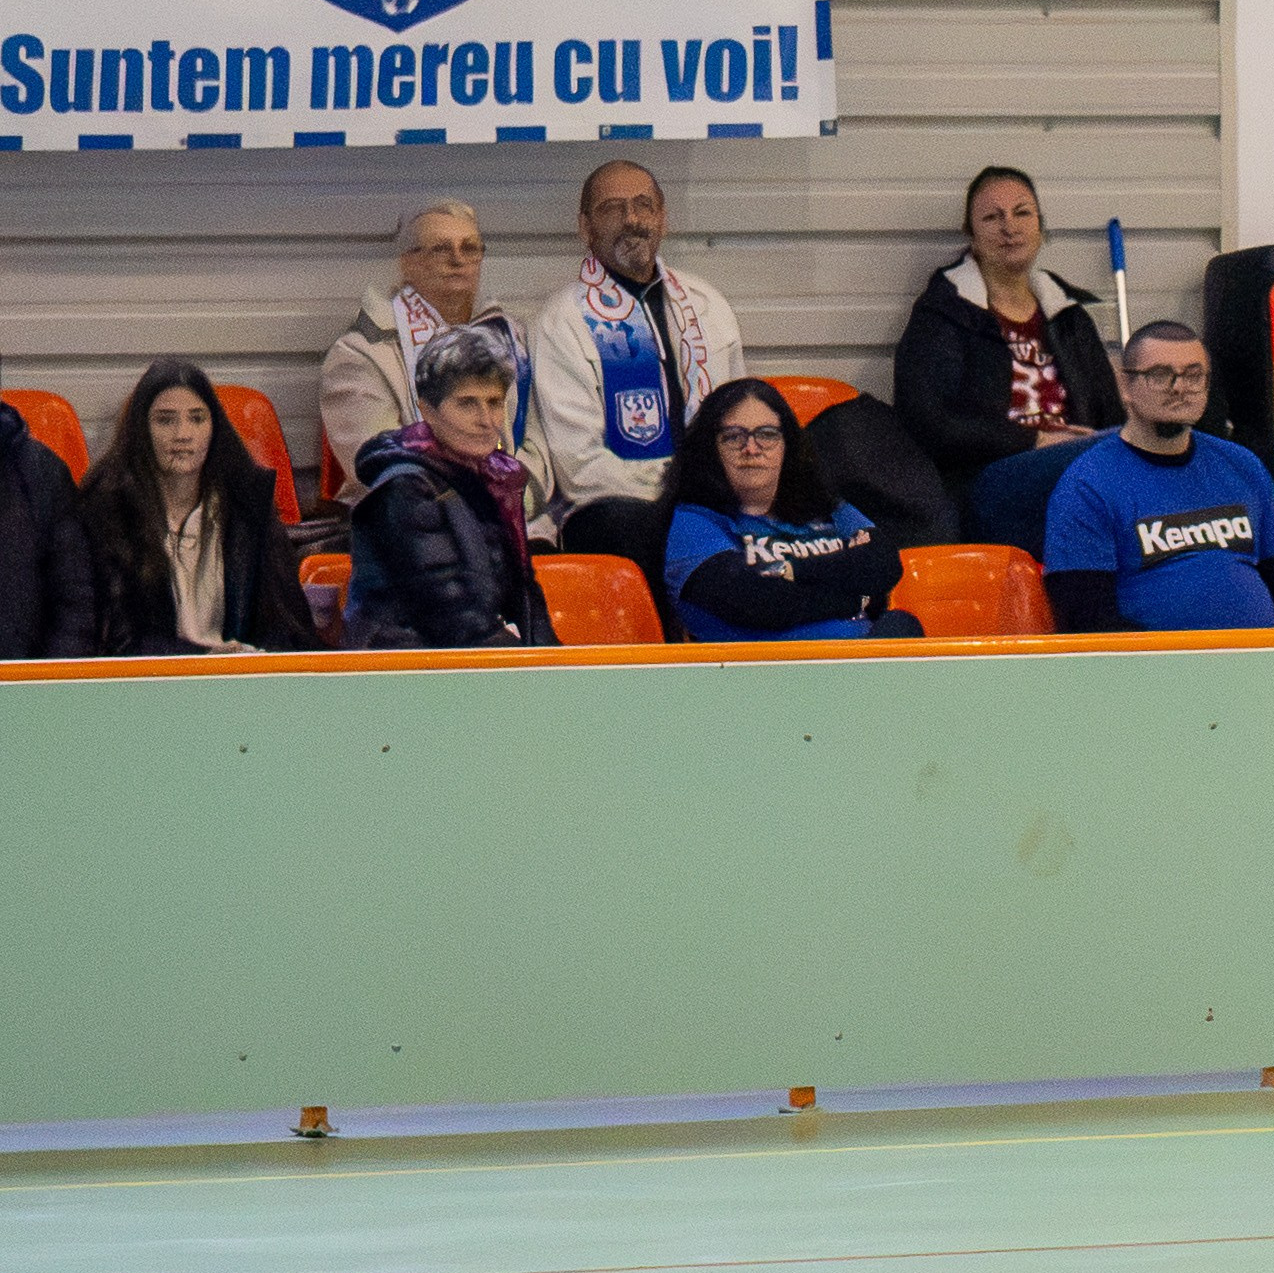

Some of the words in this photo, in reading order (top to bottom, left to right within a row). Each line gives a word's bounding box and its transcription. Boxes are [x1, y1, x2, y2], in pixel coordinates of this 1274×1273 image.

[0, 33, 291, 115] Suntem
[310, 41, 534, 110] mereu
[554, 39, 641, 104] cu
[660, 27, 799, 102] voi!
[1137, 516, 1253, 555] Kempa
